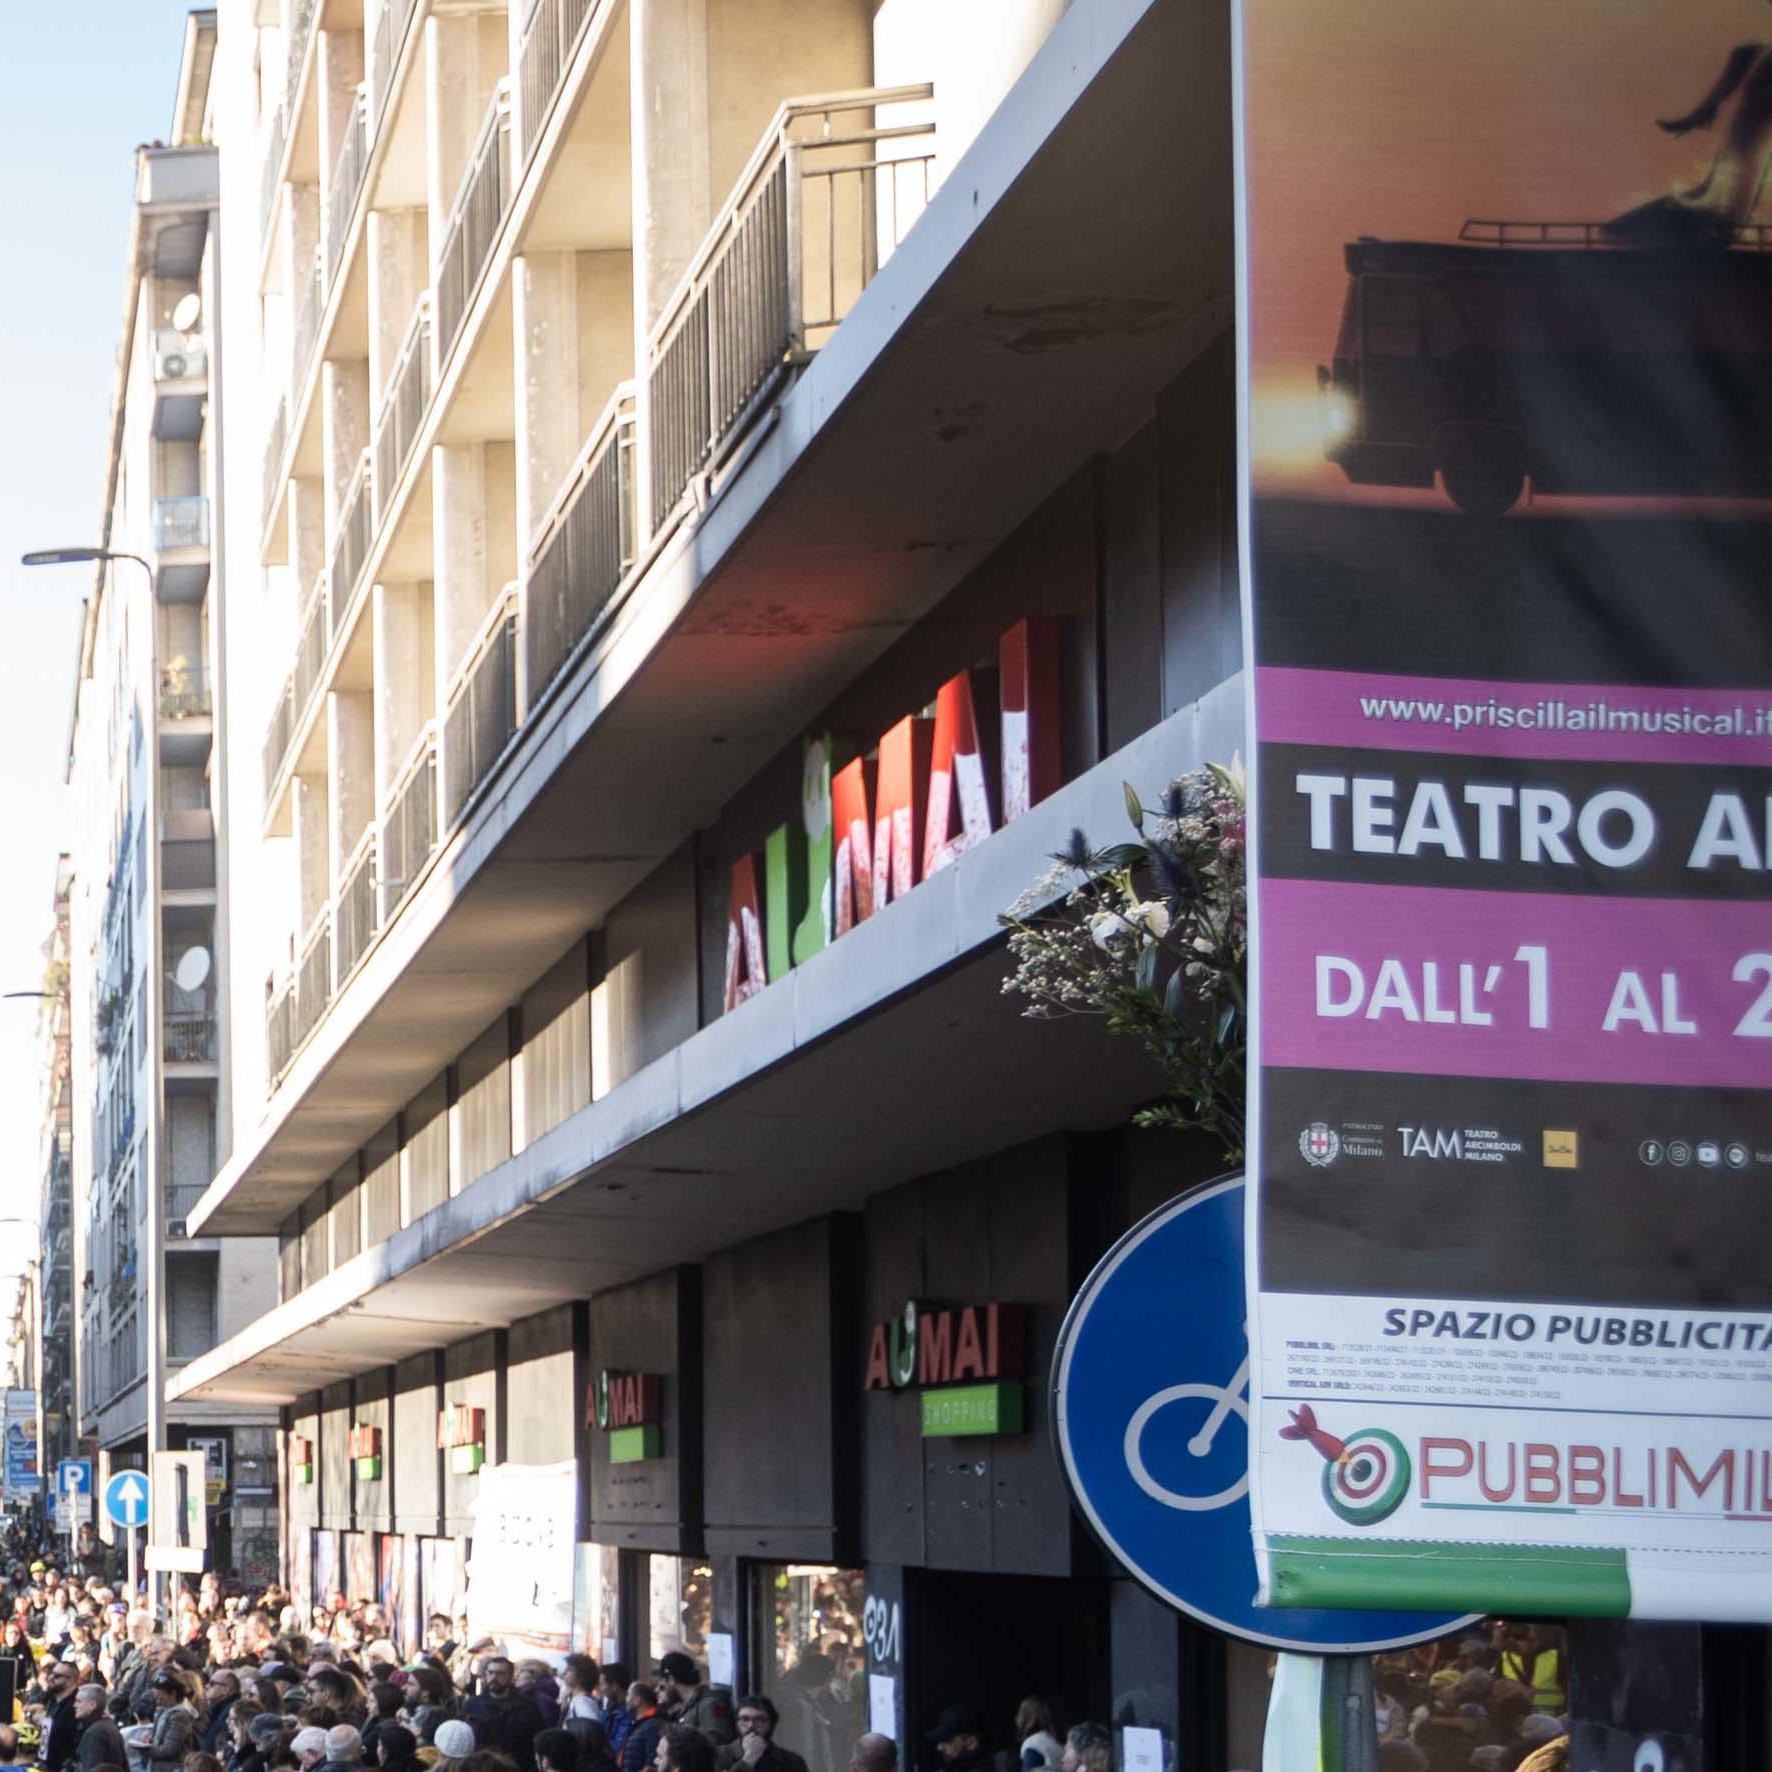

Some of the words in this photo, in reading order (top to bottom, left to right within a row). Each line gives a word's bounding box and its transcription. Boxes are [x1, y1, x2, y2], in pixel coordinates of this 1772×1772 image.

[1296, 774, 1655, 868] TEATRO
[1686, 794, 1772, 870] A
[1601, 970, 1697, 1035] AL
[1397, 1127, 1462, 1159] TAM
[1464, 1129, 1498, 1140] TEATRO
[1464, 1140, 1522, 1152] ARCIMBOLDI
[1464, 1152, 1504, 1162] MILANO
[1383, 1308, 1536, 1341] SPAZIO
[865, 1301, 998, 1391] AUMAI
